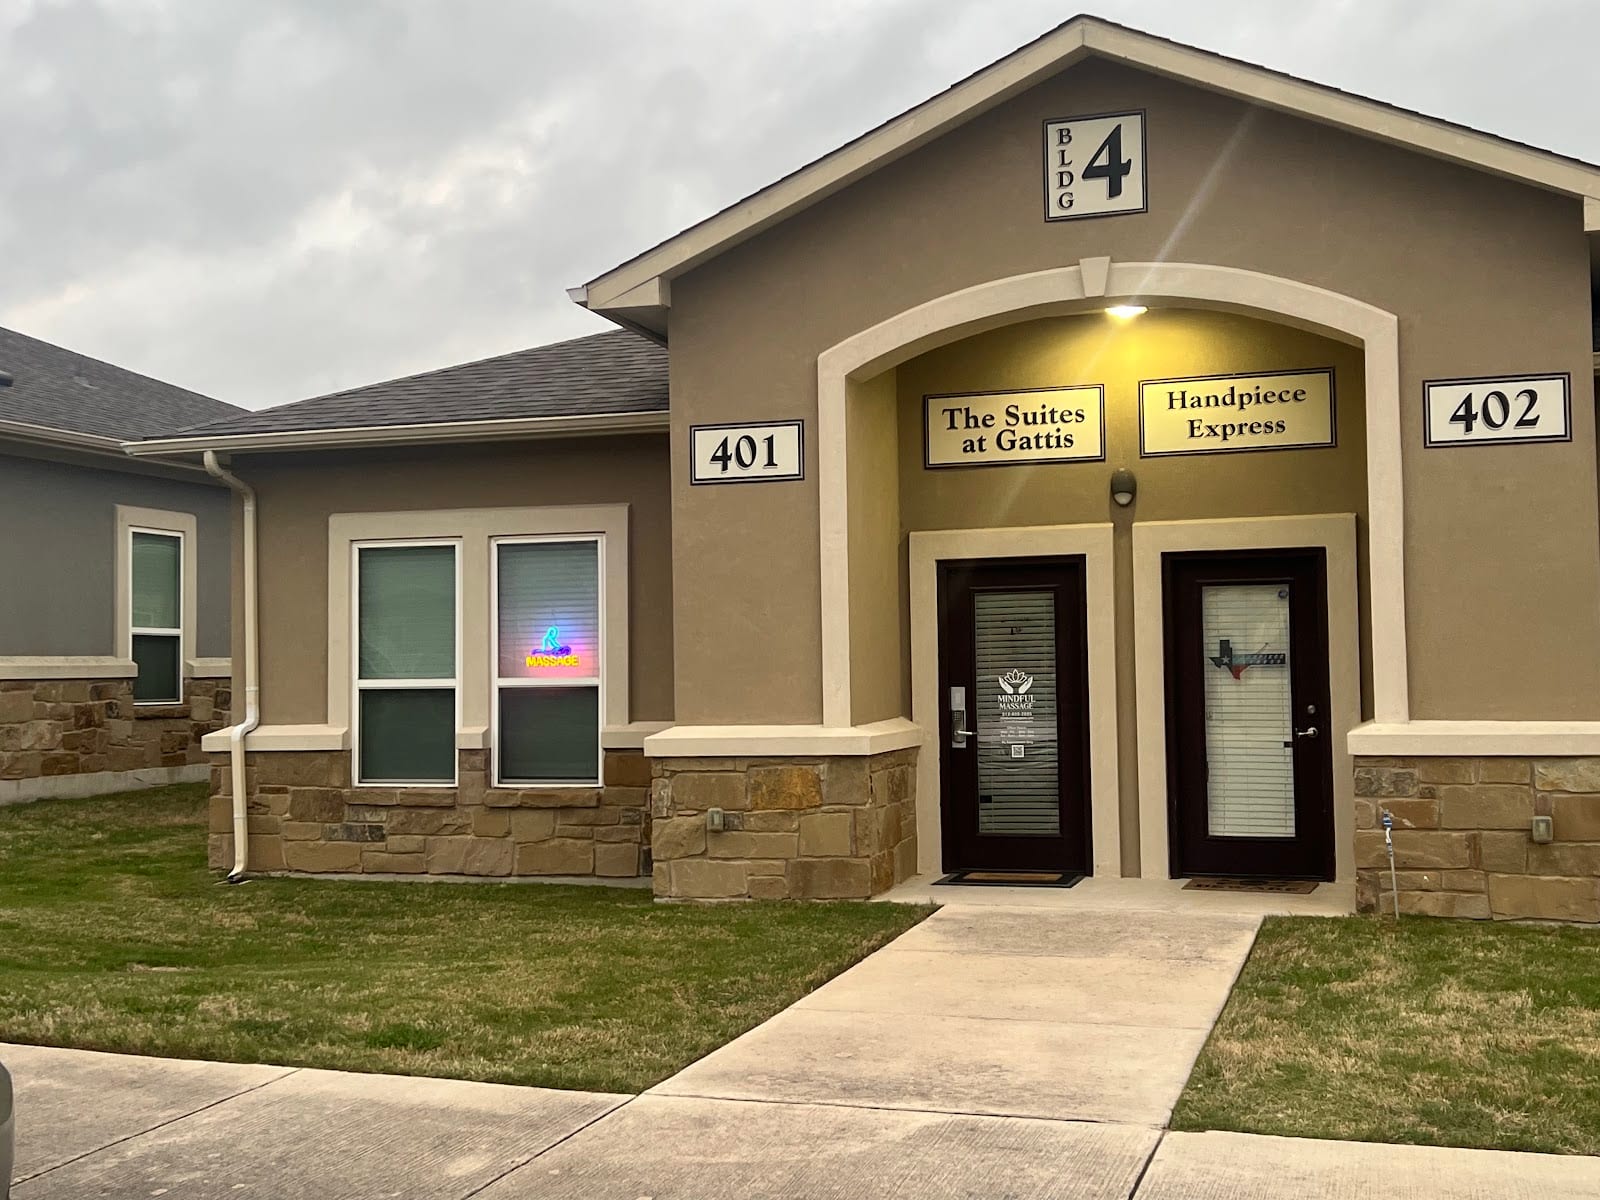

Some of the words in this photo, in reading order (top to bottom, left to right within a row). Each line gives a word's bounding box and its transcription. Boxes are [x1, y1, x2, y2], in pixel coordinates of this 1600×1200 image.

[1056, 127, 1074, 210] BLDG
[1081, 123, 1132, 200] 4
[1167, 385, 1307, 411] Handpiece
[942, 406, 995, 431] The
[1004, 403, 1086, 427] Suites
[1449, 389, 1541, 435] 402
[962, 435, 987, 453] at
[996, 427, 1075, 452] Gattis
[1187, 418, 1287, 442] Express
[710, 433, 779, 474] 401
[525, 655, 580, 668] MASSAGE
[997, 694, 1036, 703] MINDFUL
[999, 702, 1034, 710] MASSAGE
